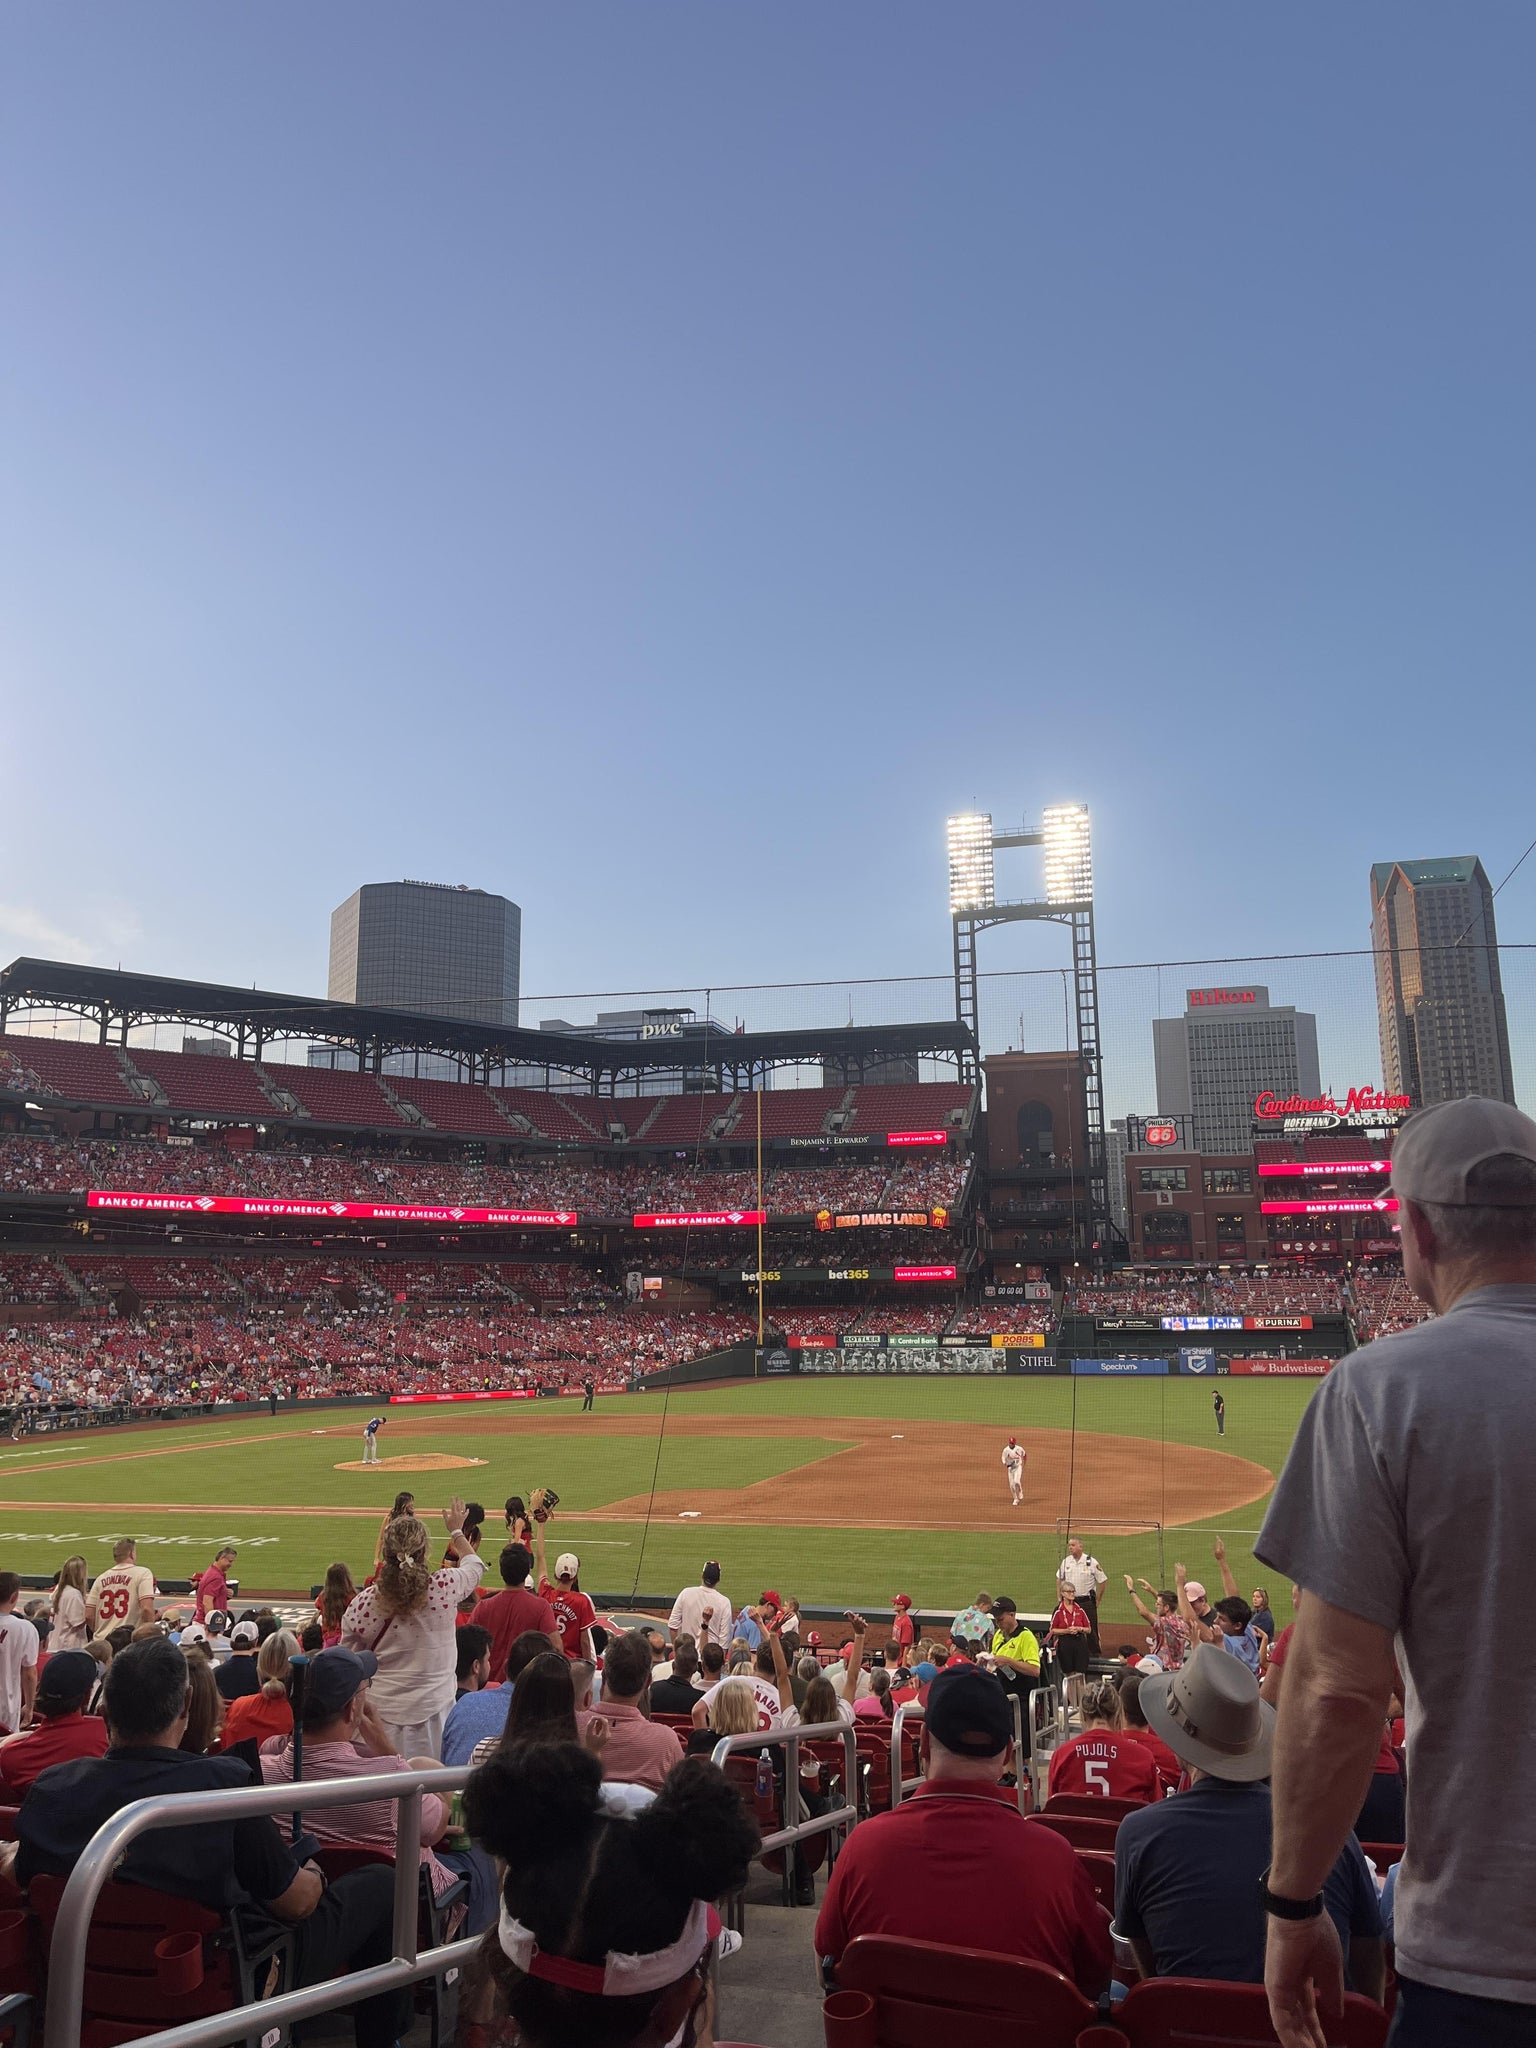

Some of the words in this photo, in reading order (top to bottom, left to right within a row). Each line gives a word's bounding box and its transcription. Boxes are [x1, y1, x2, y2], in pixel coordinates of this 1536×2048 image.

[1190, 988, 1256, 1006] Hilton
[642, 1023, 681, 1040] pwc
[1255, 1091, 1337, 1119] Cardinals
[1337, 1086, 1411, 1116] Nation
[1283, 1117, 1331, 1128] HOFFMANN
[1347, 1116, 1399, 1126] ROOFTOP
[790, 1138, 824, 1146] BENJAMIN
[834, 1136, 868, 1144] EDWARDS
[1150, 1128, 1172, 1142] 66
[98, 1197, 129, 1206] BANK
[130, 1198, 145, 1207] OF
[146, 1199, 193, 1209] AMERICA
[244, 1203, 271, 1212] BANK
[272, 1204, 285, 1213] OF
[286, 1205, 328, 1214] AMERICA
[373, 1209, 397, 1217] BANK
[398, 1210, 410, 1218] OF
[410, 1210, 448, 1218] AMERICA
[488, 1214, 510, 1222] BANK
[510, 1214, 521, 1222] OF
[522, 1214, 554, 1223] AMERICA
[690, 1216, 726, 1224] AMERICA
[836, 1214, 860, 1228] BIG
[861, 1213, 892, 1226] MAC
[893, 1213, 928, 1226] LAND
[742, 1271, 781, 1281] bet365
[828, 1270, 869, 1280] bet365
[1019, 1354, 1056, 1367] STIFEL
[1100, 1363, 1135, 1372] Spectrum
[101, 1575, 132, 1588] DONOVAN
[100, 1589, 130, 1620] 33
[551, 1602, 578, 1621] SCHMIDT
[754, 1690, 780, 1716] NADO
[1075, 1743, 1118, 1759] PUJOLS
[1085, 1760, 1110, 1797] 5
